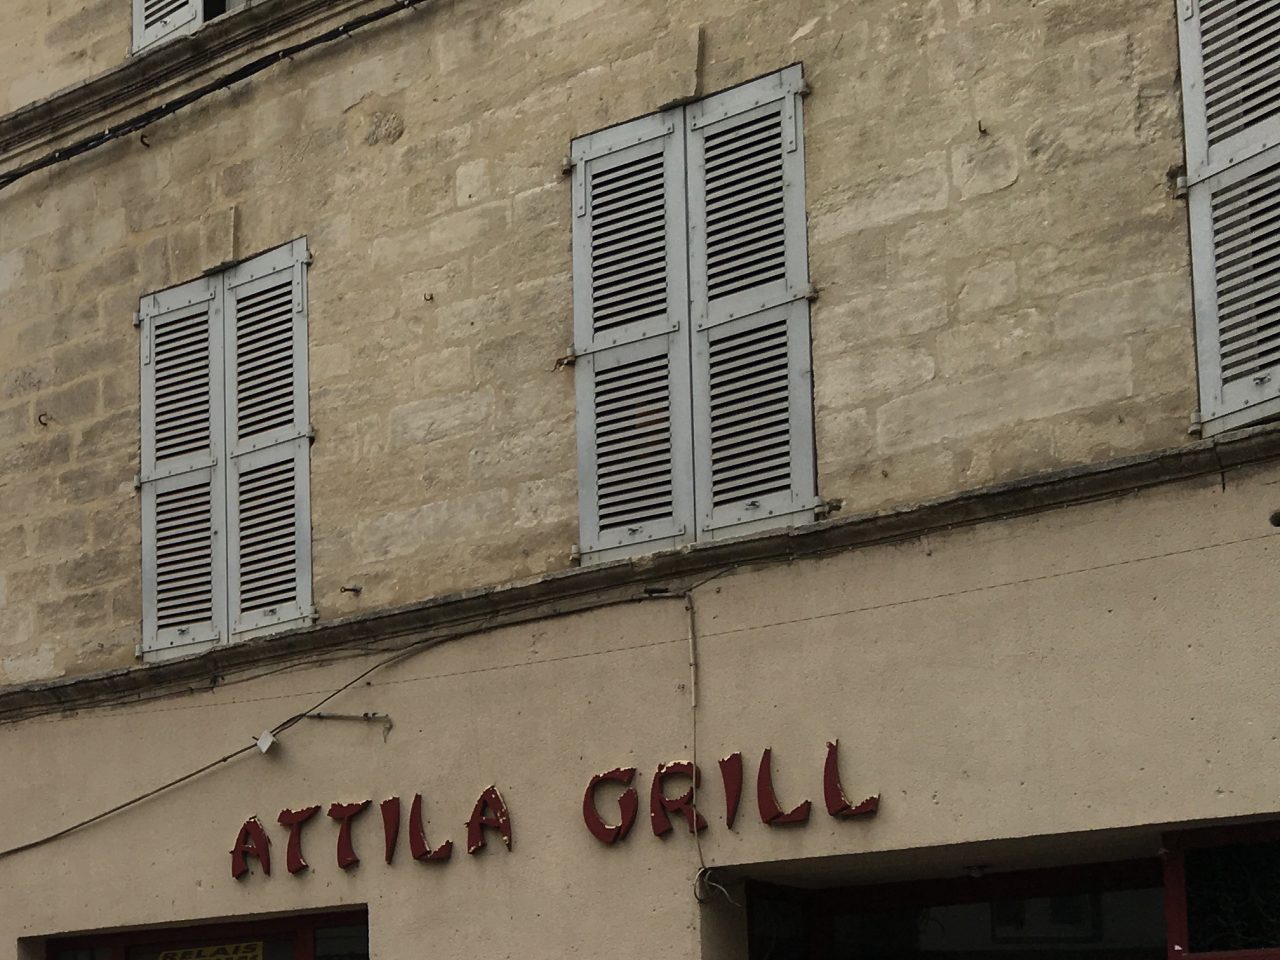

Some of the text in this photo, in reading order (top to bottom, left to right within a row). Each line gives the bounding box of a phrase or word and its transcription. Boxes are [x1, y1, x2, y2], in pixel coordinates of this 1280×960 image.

[230, 738, 881, 880] ATTILA GRILL
[163, 944, 257, 960] RELAIS
